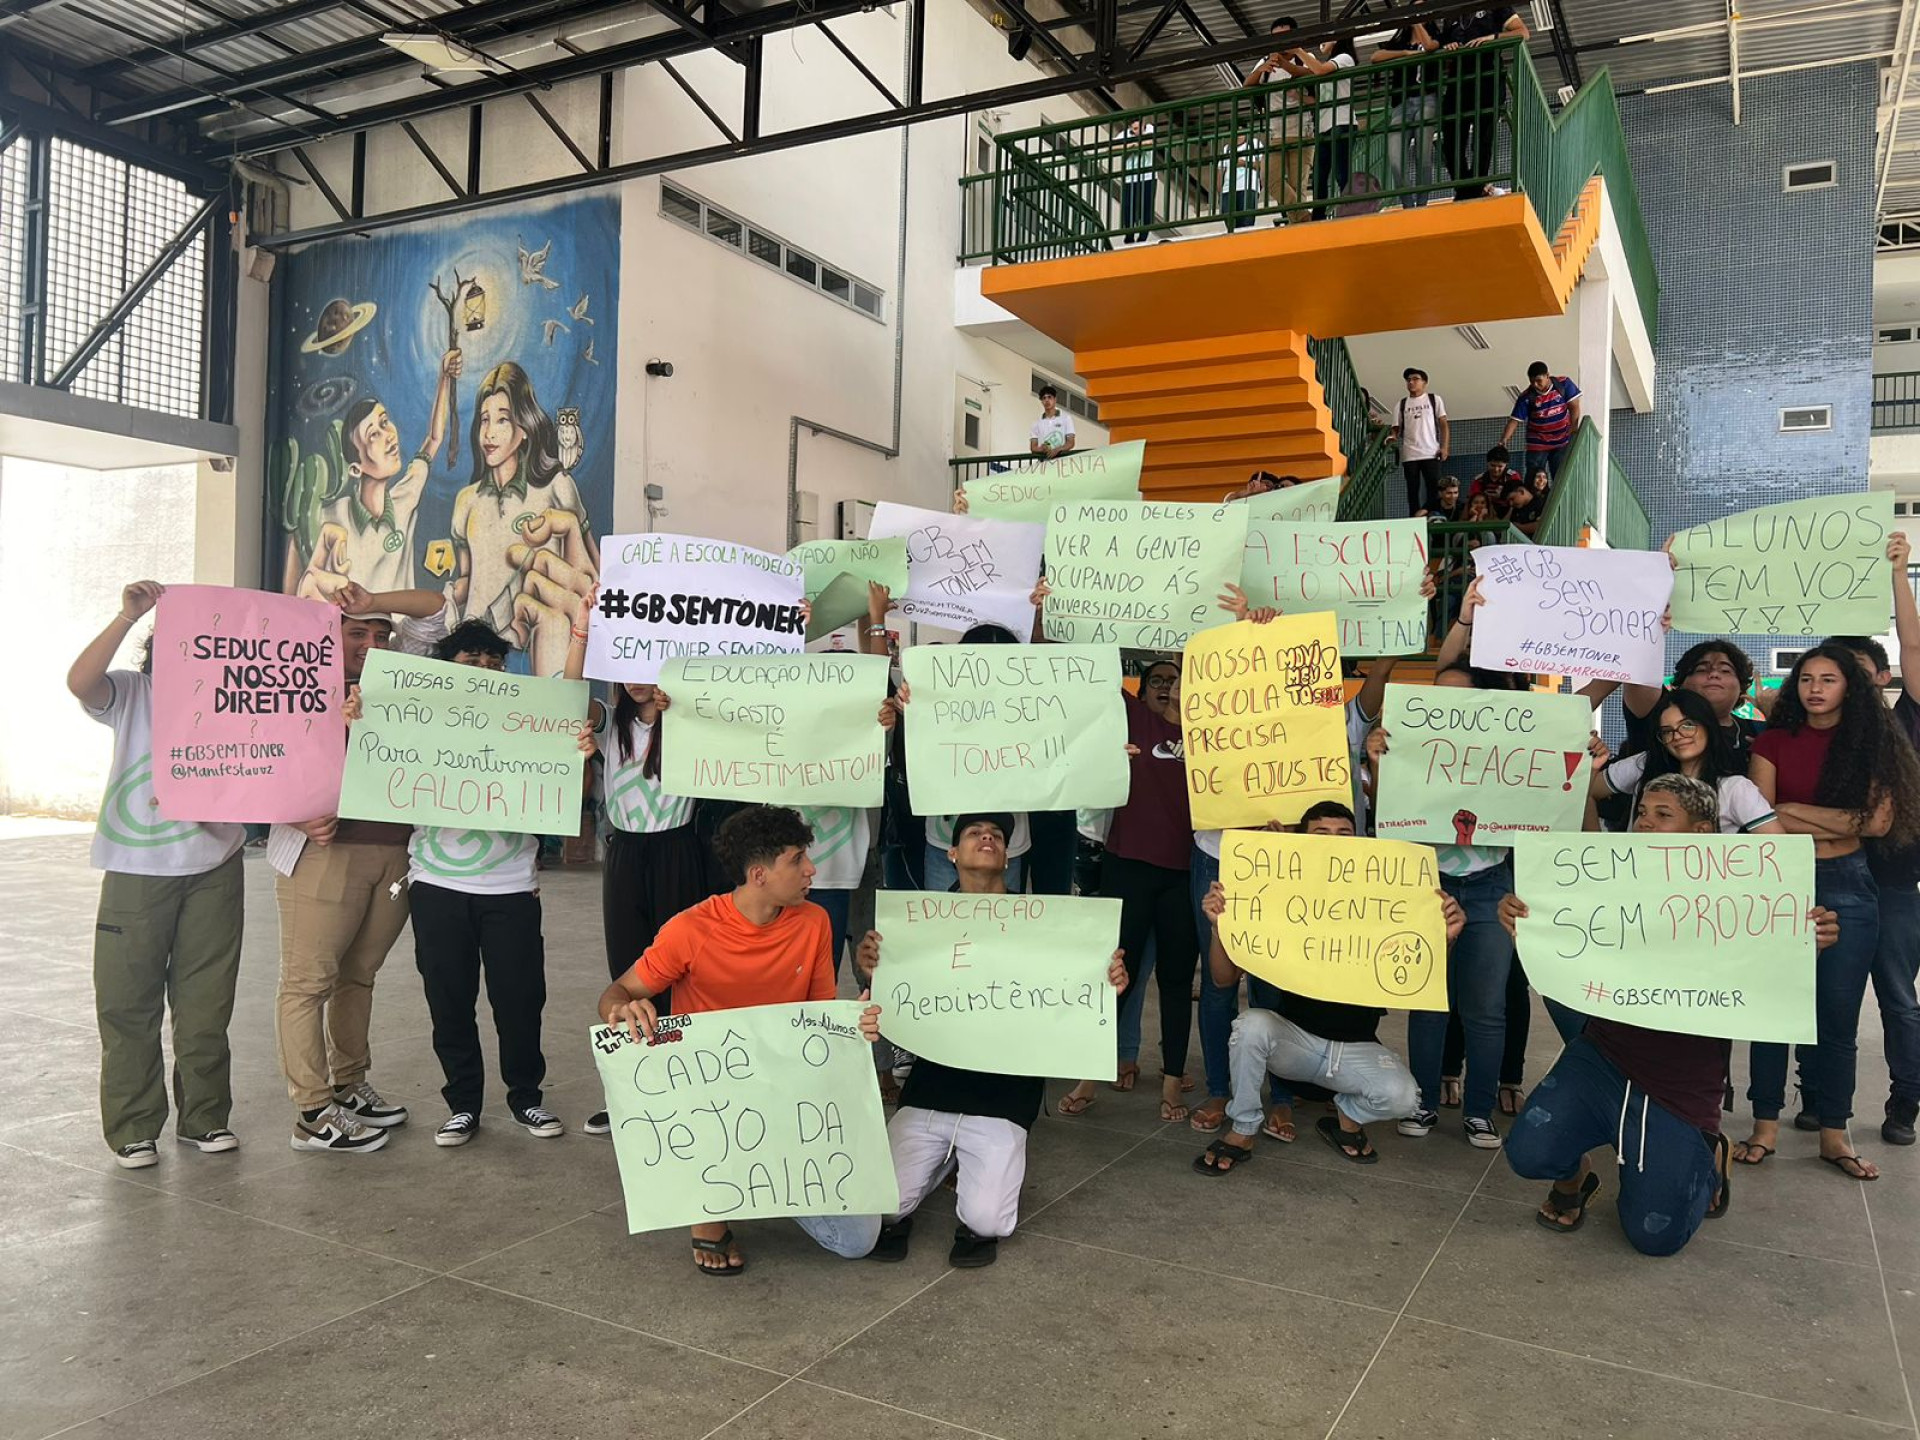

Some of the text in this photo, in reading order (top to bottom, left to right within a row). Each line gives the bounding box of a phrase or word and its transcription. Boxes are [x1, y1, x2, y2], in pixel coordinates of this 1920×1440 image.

[1055, 505, 1067, 523] O
[1141, 505, 1196, 522] DELES
[1688, 505, 1884, 553] ALUNOS
[622, 537, 663, 565] CADÊ
[670, 542, 680, 564] A
[685, 543, 737, 565] ESCOLA
[850, 541, 880, 563] NÃO
[947, 539, 996, 573] SEM
[1055, 534, 1092, 559] VER
[1105, 534, 1120, 559] A
[1243, 527, 1428, 567] A ESCOLA
[928, 563, 1003, 598] TONER
[1046, 563, 1145, 594] OCUPANDO
[1300, 570, 1321, 601] O
[1338, 570, 1405, 598] MEU
[1676, 556, 1881, 603] TEM VOZ
[598, 587, 805, 636] #GBSEMTONER
[611, 636, 652, 660] SEM
[656, 639, 711, 659] TONER
[1091, 619, 1120, 644] AS
[1340, 618, 1426, 649] DE FALA
[193, 633, 334, 667] SEDUC CADÊ
[1188, 645, 1268, 684] NOSSA
[222, 664, 320, 691] NOSSOS
[464, 677, 521, 698] SALAS
[682, 658, 855, 690] EDUCAÇÃO NÃO
[932, 653, 1108, 690] NÃO SE FAZ
[214, 689, 328, 714] DIREITOS
[371, 697, 584, 737] NÃO SÃO SAUNAS
[695, 691, 786, 726] É GASTO
[934, 694, 1067, 725] PROVA SEM
[358, 730, 424, 765] Para
[767, 728, 785, 758] É
[693, 754, 882, 789] INVESTIMENTO!!!
[1190, 766, 1223, 795] DE
[1421, 738, 1584, 792] REAGE!
[1233, 842, 1303, 882] SALA
[1365, 855, 1434, 888] AULA
[1553, 841, 1783, 887] SEM TONER
[906, 895, 1047, 932] EDUCAÇÃO
[1223, 883, 1408, 927] TÁ QUENTE
[1230, 930, 1281, 960] MEU
[1552, 903, 1647, 959] SEM
[951, 932, 973, 970] É
[1580, 980, 1747, 1008] #GBSEMTONER
[802, 1033, 830, 1068] O
[797, 1101, 845, 1145] DA
[701, 1151, 855, 1216] SALA?
